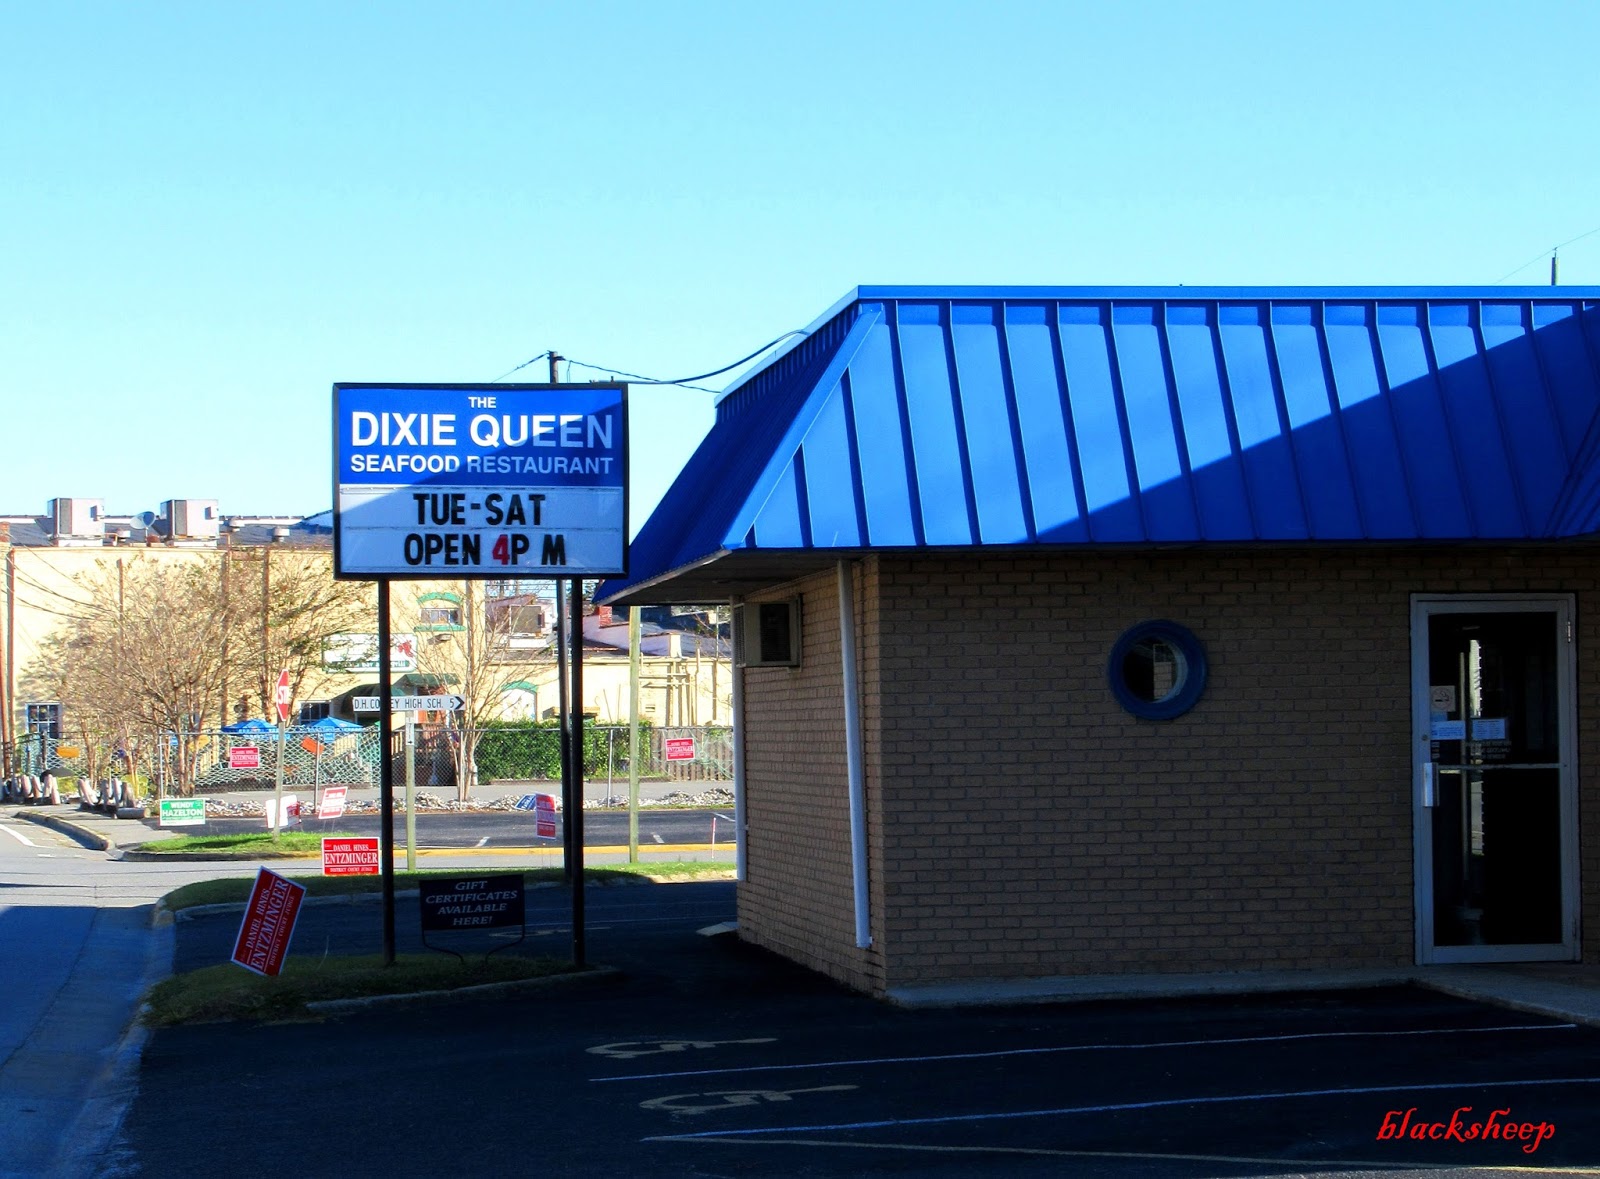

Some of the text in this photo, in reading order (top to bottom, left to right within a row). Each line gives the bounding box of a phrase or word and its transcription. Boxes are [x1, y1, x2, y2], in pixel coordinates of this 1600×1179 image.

[468, 396, 497, 409] THE
[351, 411, 613, 449] DIXIE QUEEN
[350, 454, 614, 475] SEAFOOD RESTAURANT
[413, 493, 546, 526] TUE-SAT
[404, 533, 481, 566] OPEN
[370, 698, 400, 709] COEY
[404, 698, 423, 709] HIGH
[427, 698, 444, 709] SCH.
[449, 698, 455, 709] 5
[170, 801, 194, 809] WENDY
[162, 809, 203, 817] HAZELTON
[333, 844, 352, 852] DANIEL
[353, 843, 369, 852] HINES
[325, 852, 378, 864] ENTZMINGER
[454, 880, 489, 891] GIFT
[425, 890, 519, 904] CERTIFICATES
[437, 902, 508, 915] AVAILABLE
[246, 889, 271, 949] DANIEL HINES
[251, 880, 290, 970] ENTZMINGER
[452, 915, 494, 926] HERE!
